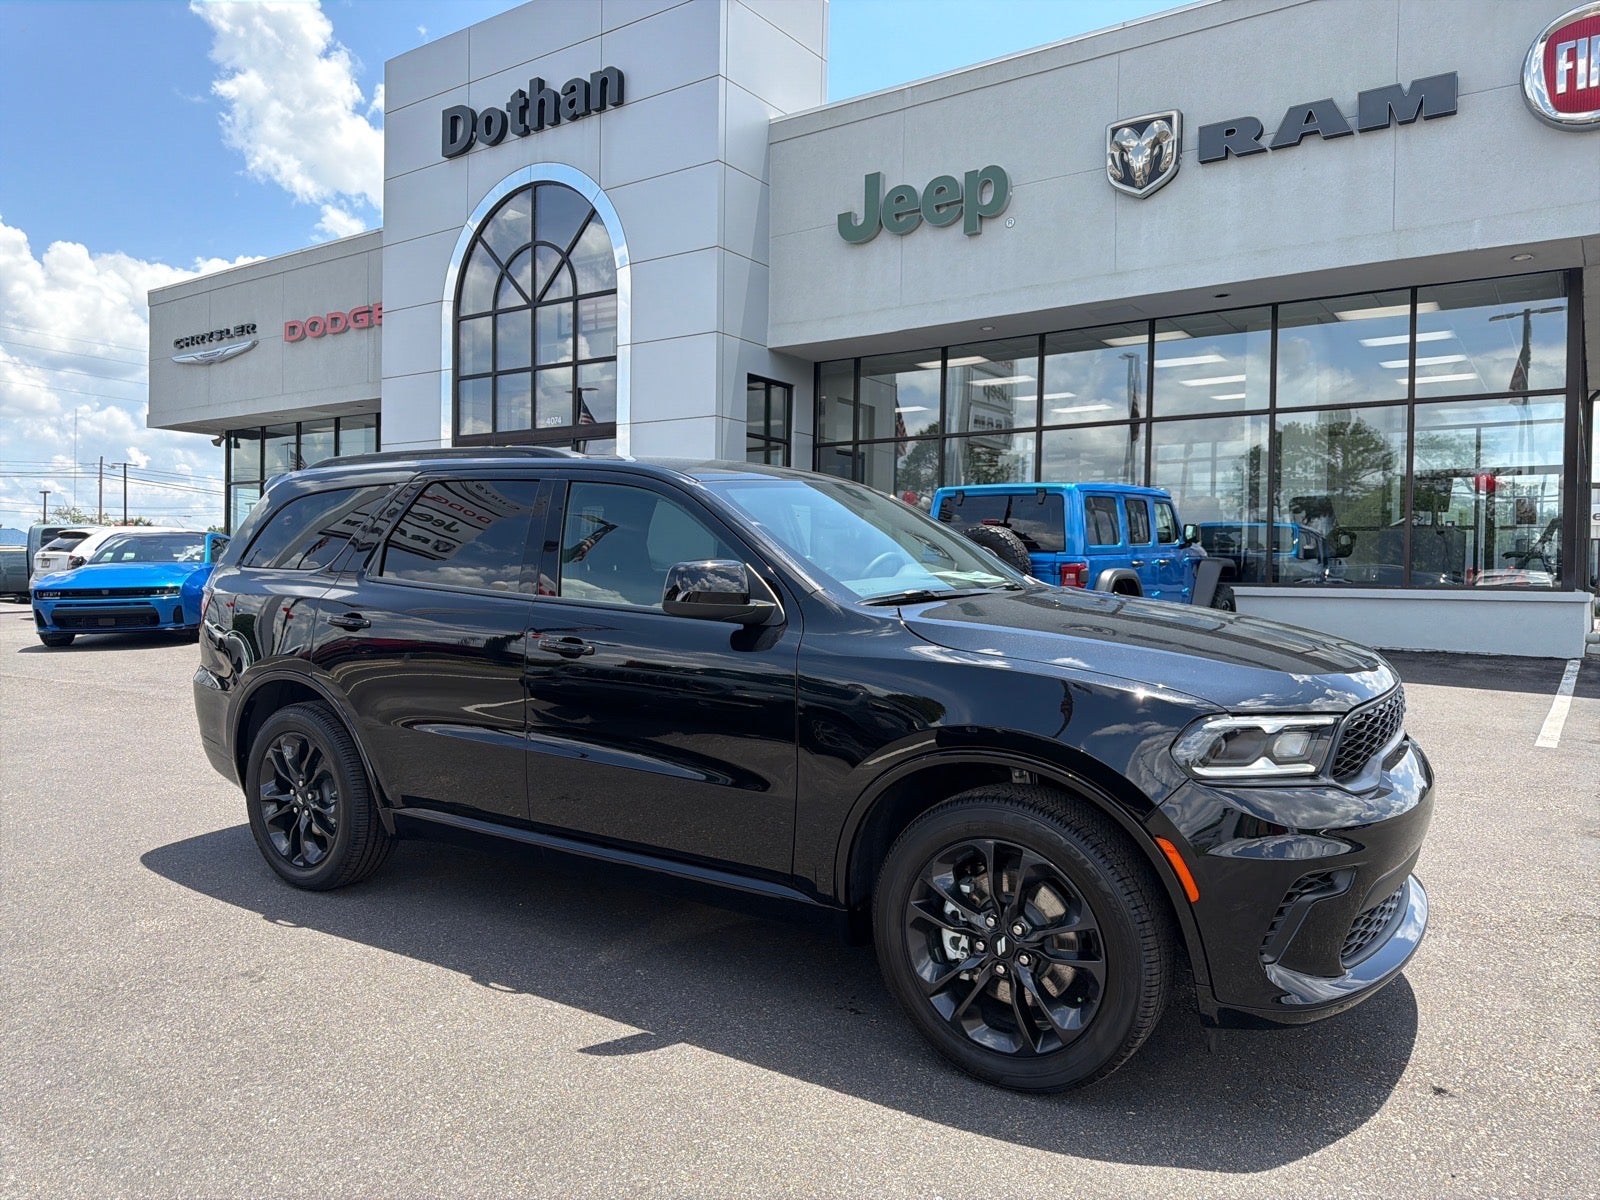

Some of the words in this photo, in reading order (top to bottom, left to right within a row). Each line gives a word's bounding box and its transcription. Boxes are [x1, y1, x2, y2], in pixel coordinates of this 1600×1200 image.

[442, 66, 624, 159] Dothan
[1198, 71, 1458, 164] RAM
[837, 165, 1012, 244] Jeep
[174, 323, 257, 349] CHRYSLER
[546, 416, 562, 425] 4074
